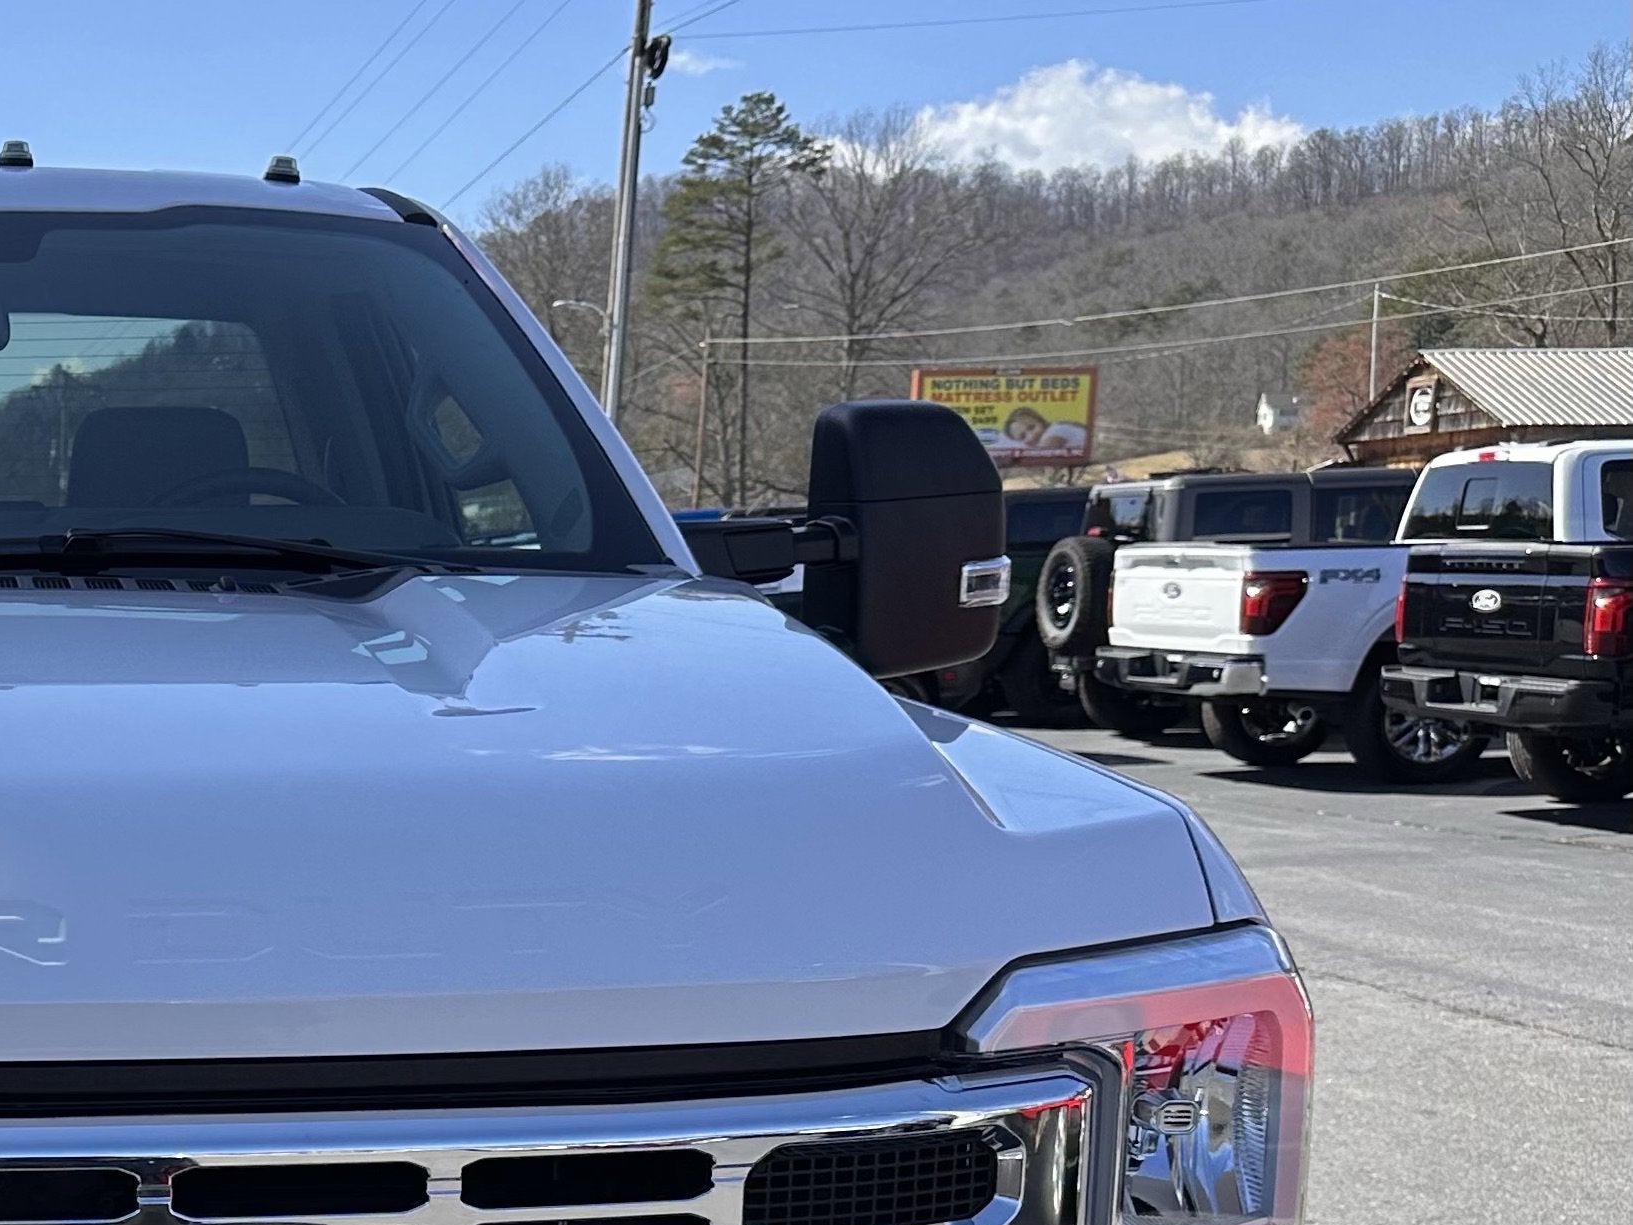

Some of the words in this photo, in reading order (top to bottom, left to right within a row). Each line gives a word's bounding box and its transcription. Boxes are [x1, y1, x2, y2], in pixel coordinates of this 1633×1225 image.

[930, 378, 1001, 391] NOTHING
[1005, 378, 1035, 390] BUT
[1040, 377, 1080, 390] BEDS
[930, 390, 1013, 403] MATTRESS
[1017, 390, 1080, 402] OUTLET
[1319, 567, 1381, 585] FX4
